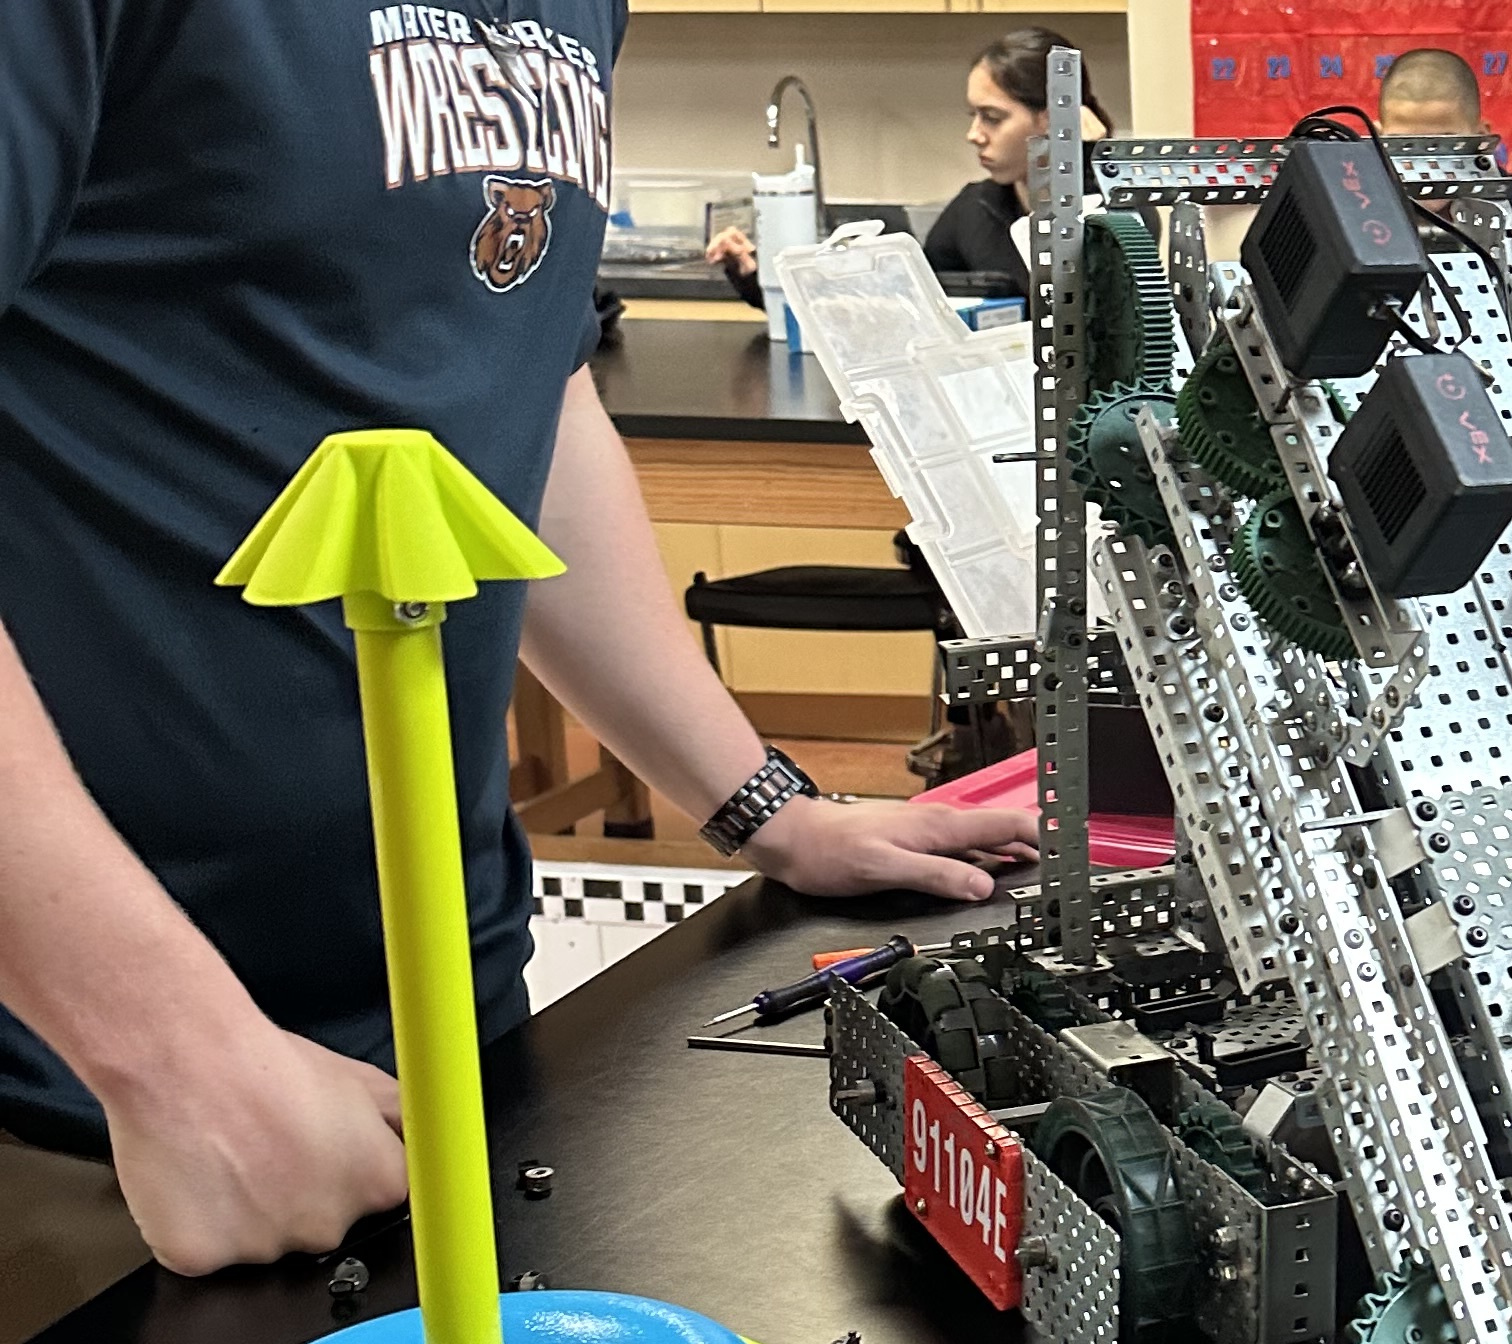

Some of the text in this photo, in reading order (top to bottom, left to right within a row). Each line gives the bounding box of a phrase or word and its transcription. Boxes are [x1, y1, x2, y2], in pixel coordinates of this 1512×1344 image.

[370, 4, 475, 45] MATER
[1211, 57, 1236, 81] 22
[1266, 55, 1291, 80] 23
[1319, 55, 1343, 79] 24
[1483, 52, 1508, 76] 27
[1342, 160, 1371, 210] VEX
[1458, 410, 1493, 464] VEX
[912, 1098, 1007, 1264] 91104E
